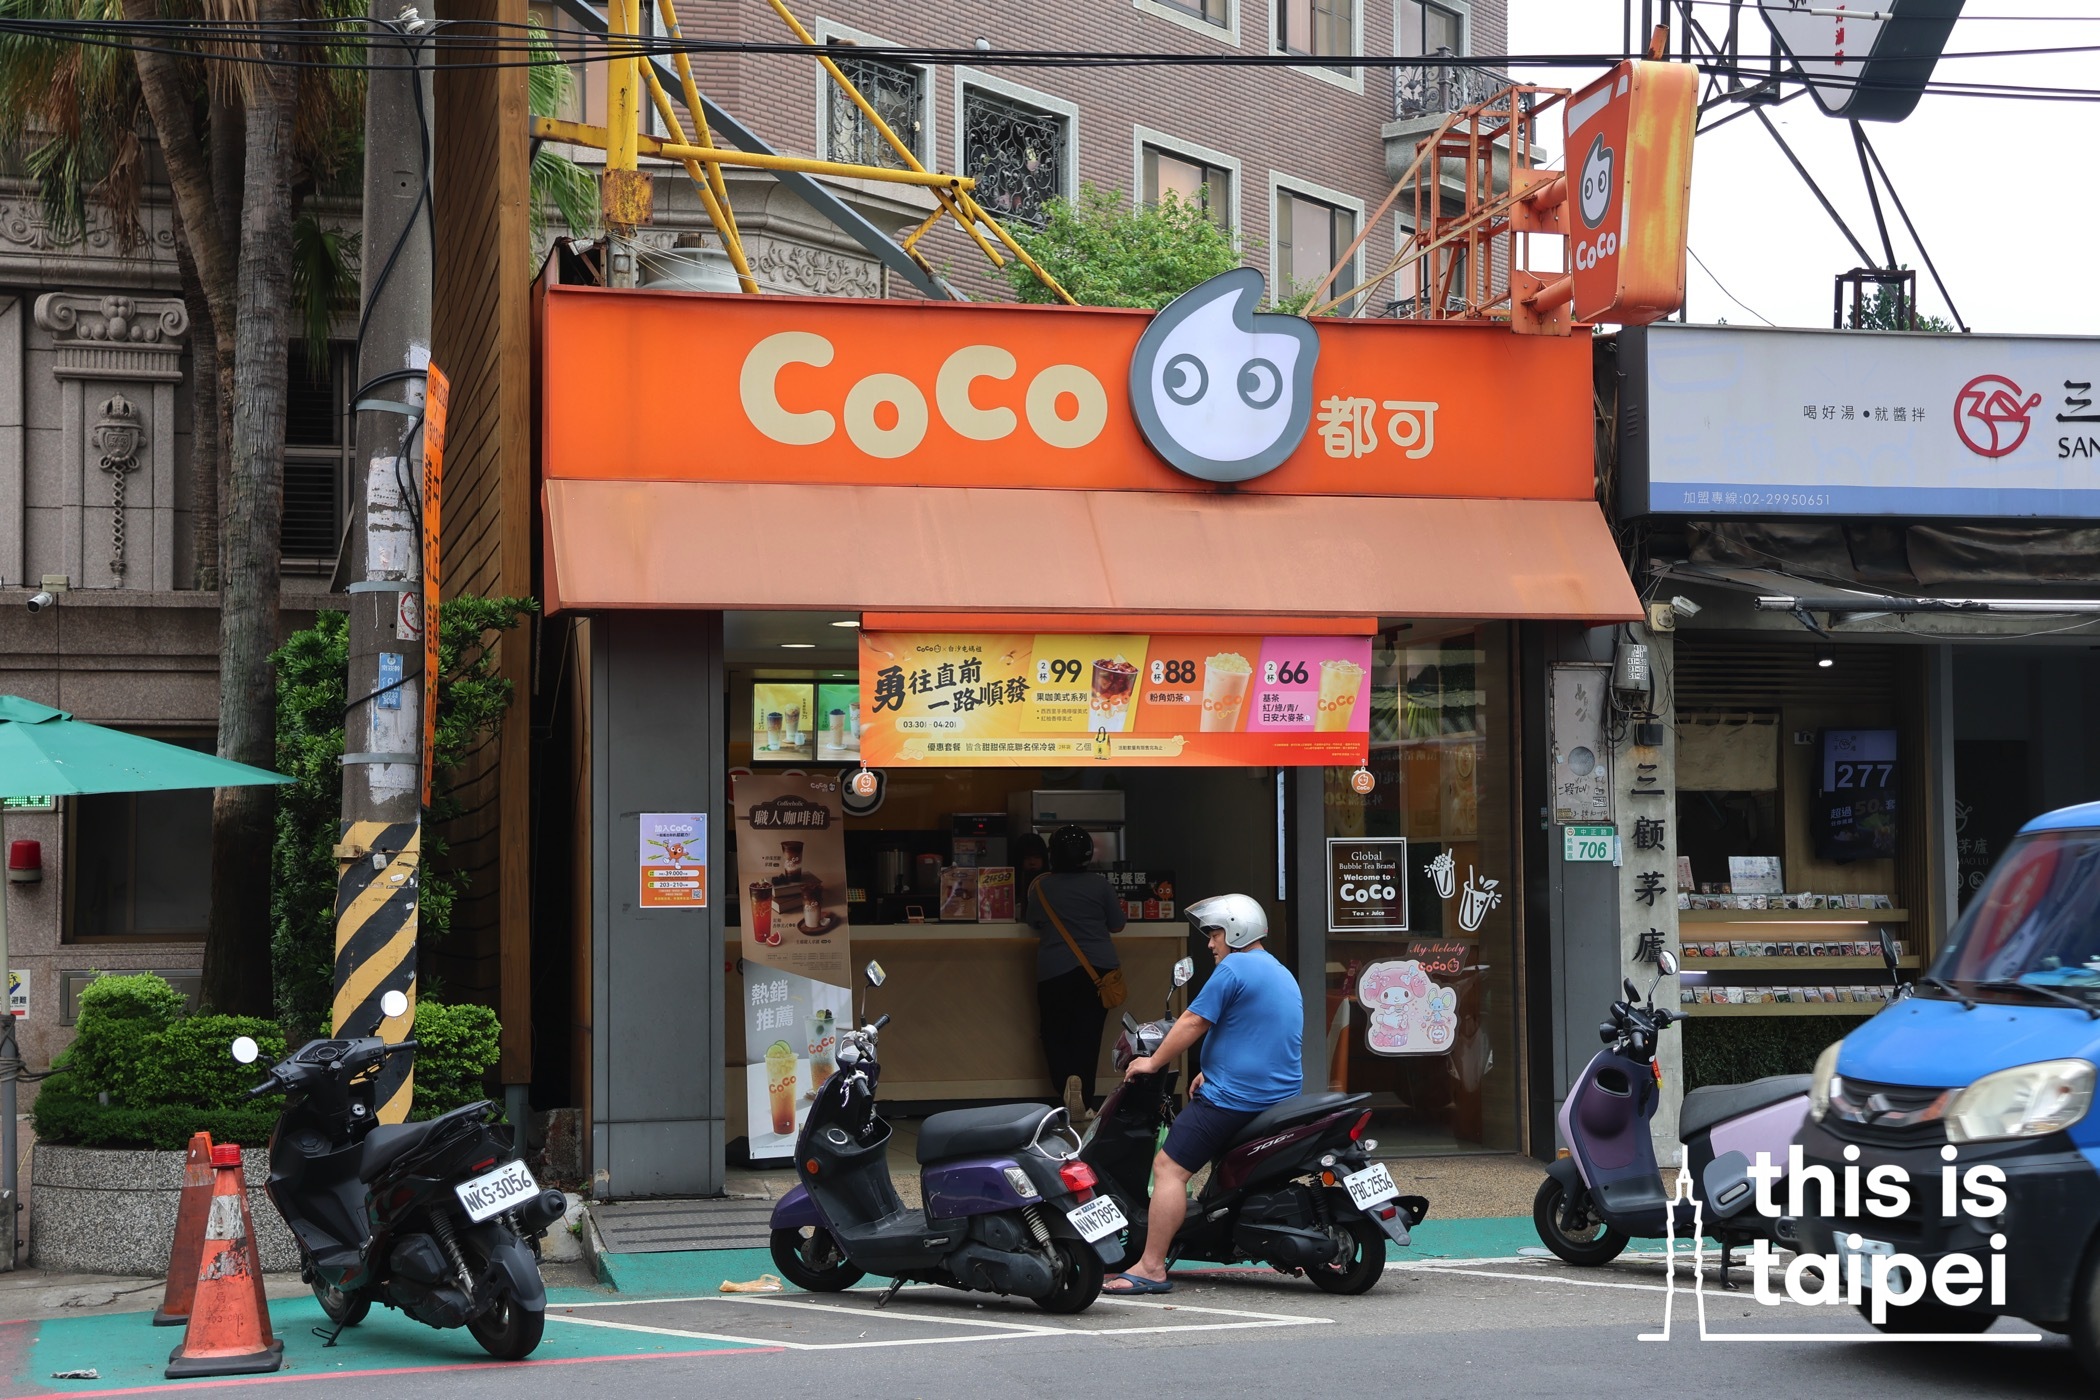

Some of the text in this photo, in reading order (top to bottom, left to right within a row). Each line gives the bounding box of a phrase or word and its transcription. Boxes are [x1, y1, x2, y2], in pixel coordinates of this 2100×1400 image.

[1576, 232, 1616, 271] CoCo
[740, 331, 1107, 458] CoCo
[2056, 380, 2100, 422] 三
[1316, 396, 1439, 459] 都可
[1684, 491, 1830, 505] 加盟專線:02-29950651
[1050, 659, 1082, 683] 99
[1165, 660, 1196, 684] 88
[1279, 661, 1308, 684] 66
[872, 656, 983, 713] 勇往直前
[927, 674, 1031, 713] 一路順發
[1036, 692, 1088, 702] 果咖美式系列
[1149, 693, 1184, 703] 粉角奶茶
[1203, 694, 1243, 711] CoCo
[1262, 693, 1280, 703] 基茶
[1317, 695, 1355, 711] CoCo
[1262, 713, 1304, 723] 日安大麥茶
[927, 743, 961, 751] 優惠套餐
[1837, 764, 1893, 788] 277
[754, 810, 826, 826] 職人咖啡館
[1351, 851, 1382, 862] Global
[1578, 841, 1608, 858] 706
[1343, 873, 1391, 881] Welcome to
[1340, 884, 1396, 903] CoCo
[1409, 943, 1466, 957] My Melody
[1418, 962, 1446, 972] CoCo
[751, 979, 789, 1006] 熱銷
[756, 1004, 794, 1032] 推薦
[808, 1036, 835, 1054] CoCo
[768, 1075, 797, 1094] CoCo
[1247, 1134, 1288, 1156] JOG
